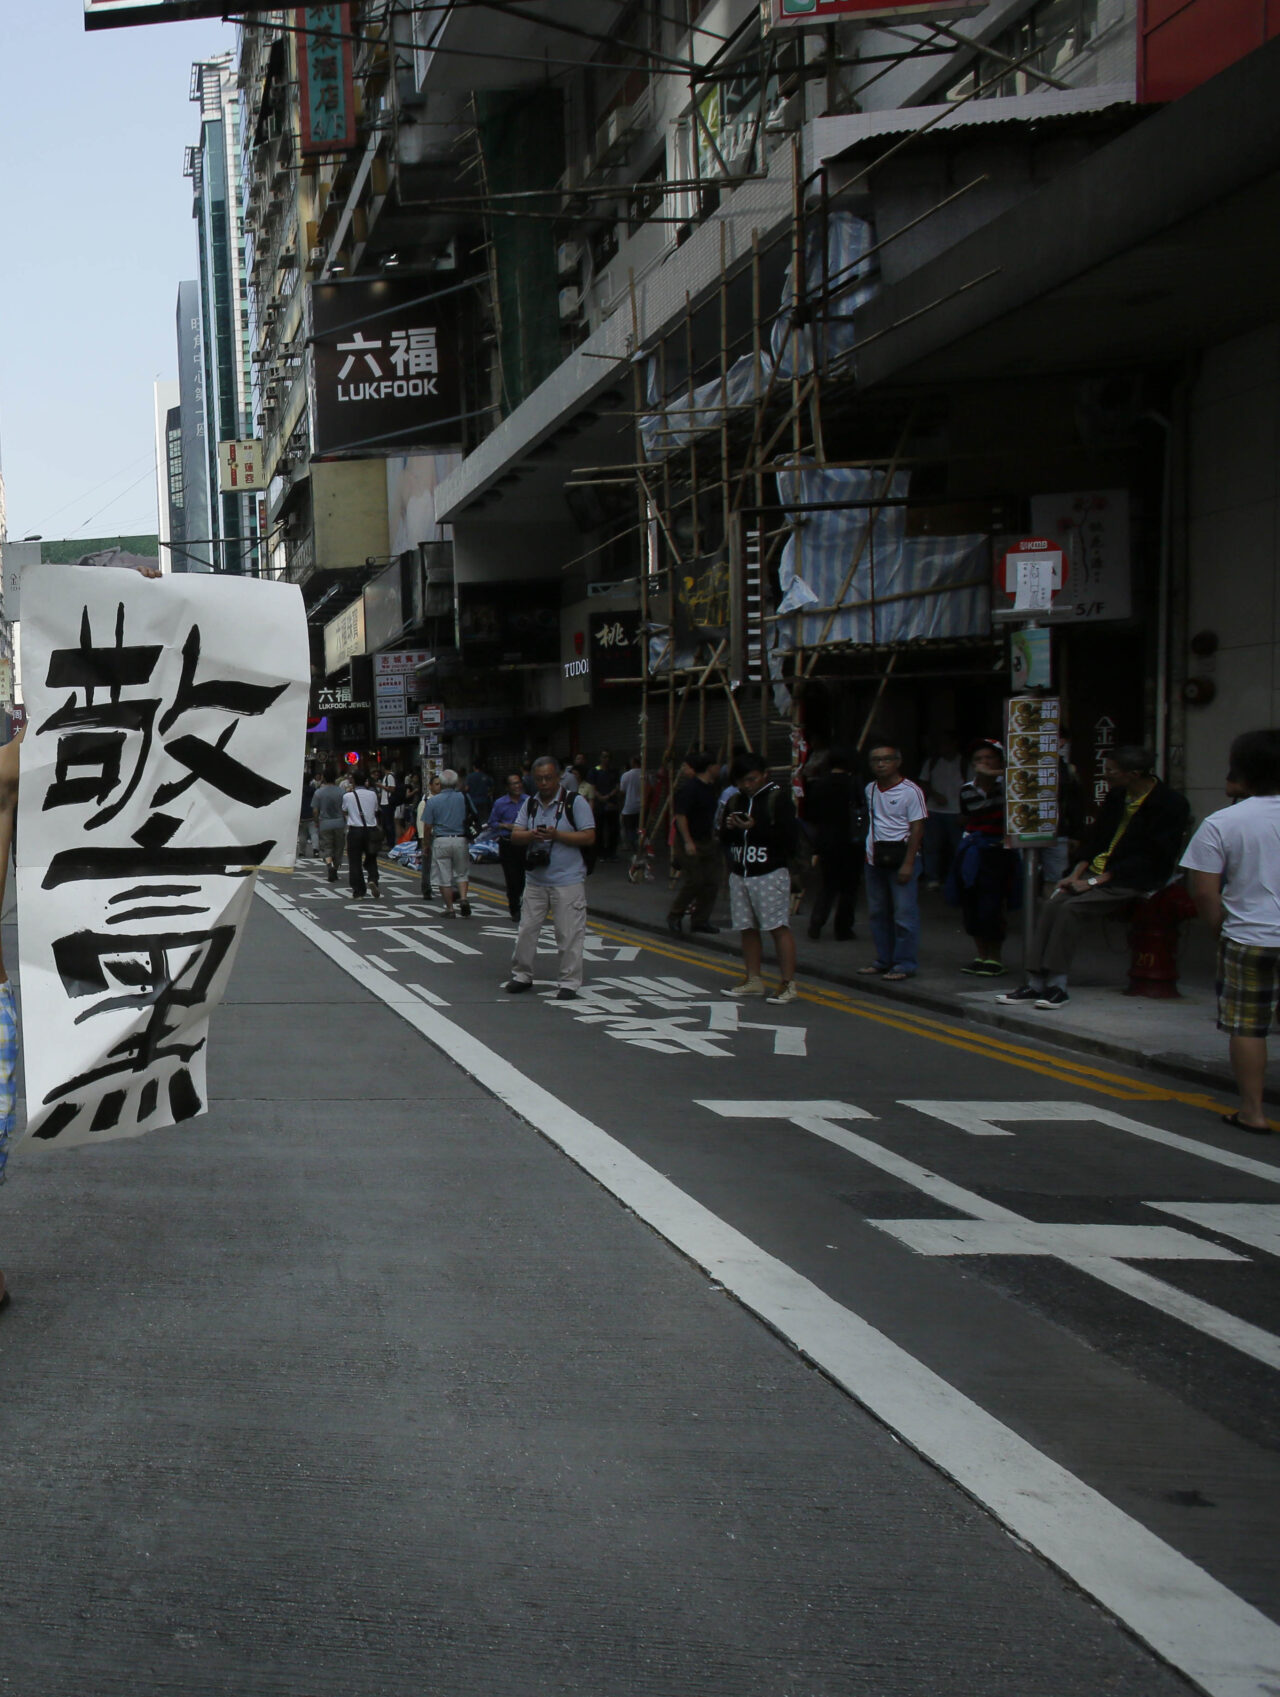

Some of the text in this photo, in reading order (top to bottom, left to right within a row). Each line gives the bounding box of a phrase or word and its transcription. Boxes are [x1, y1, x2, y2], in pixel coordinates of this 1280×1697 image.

[336, 326, 439, 381] 六福
[337, 377, 439, 402] LUKFOOK
[1075, 602, 1106, 616] 5/F
[318, 687, 351, 703] 六福
[746, 845, 768, 863] 85
